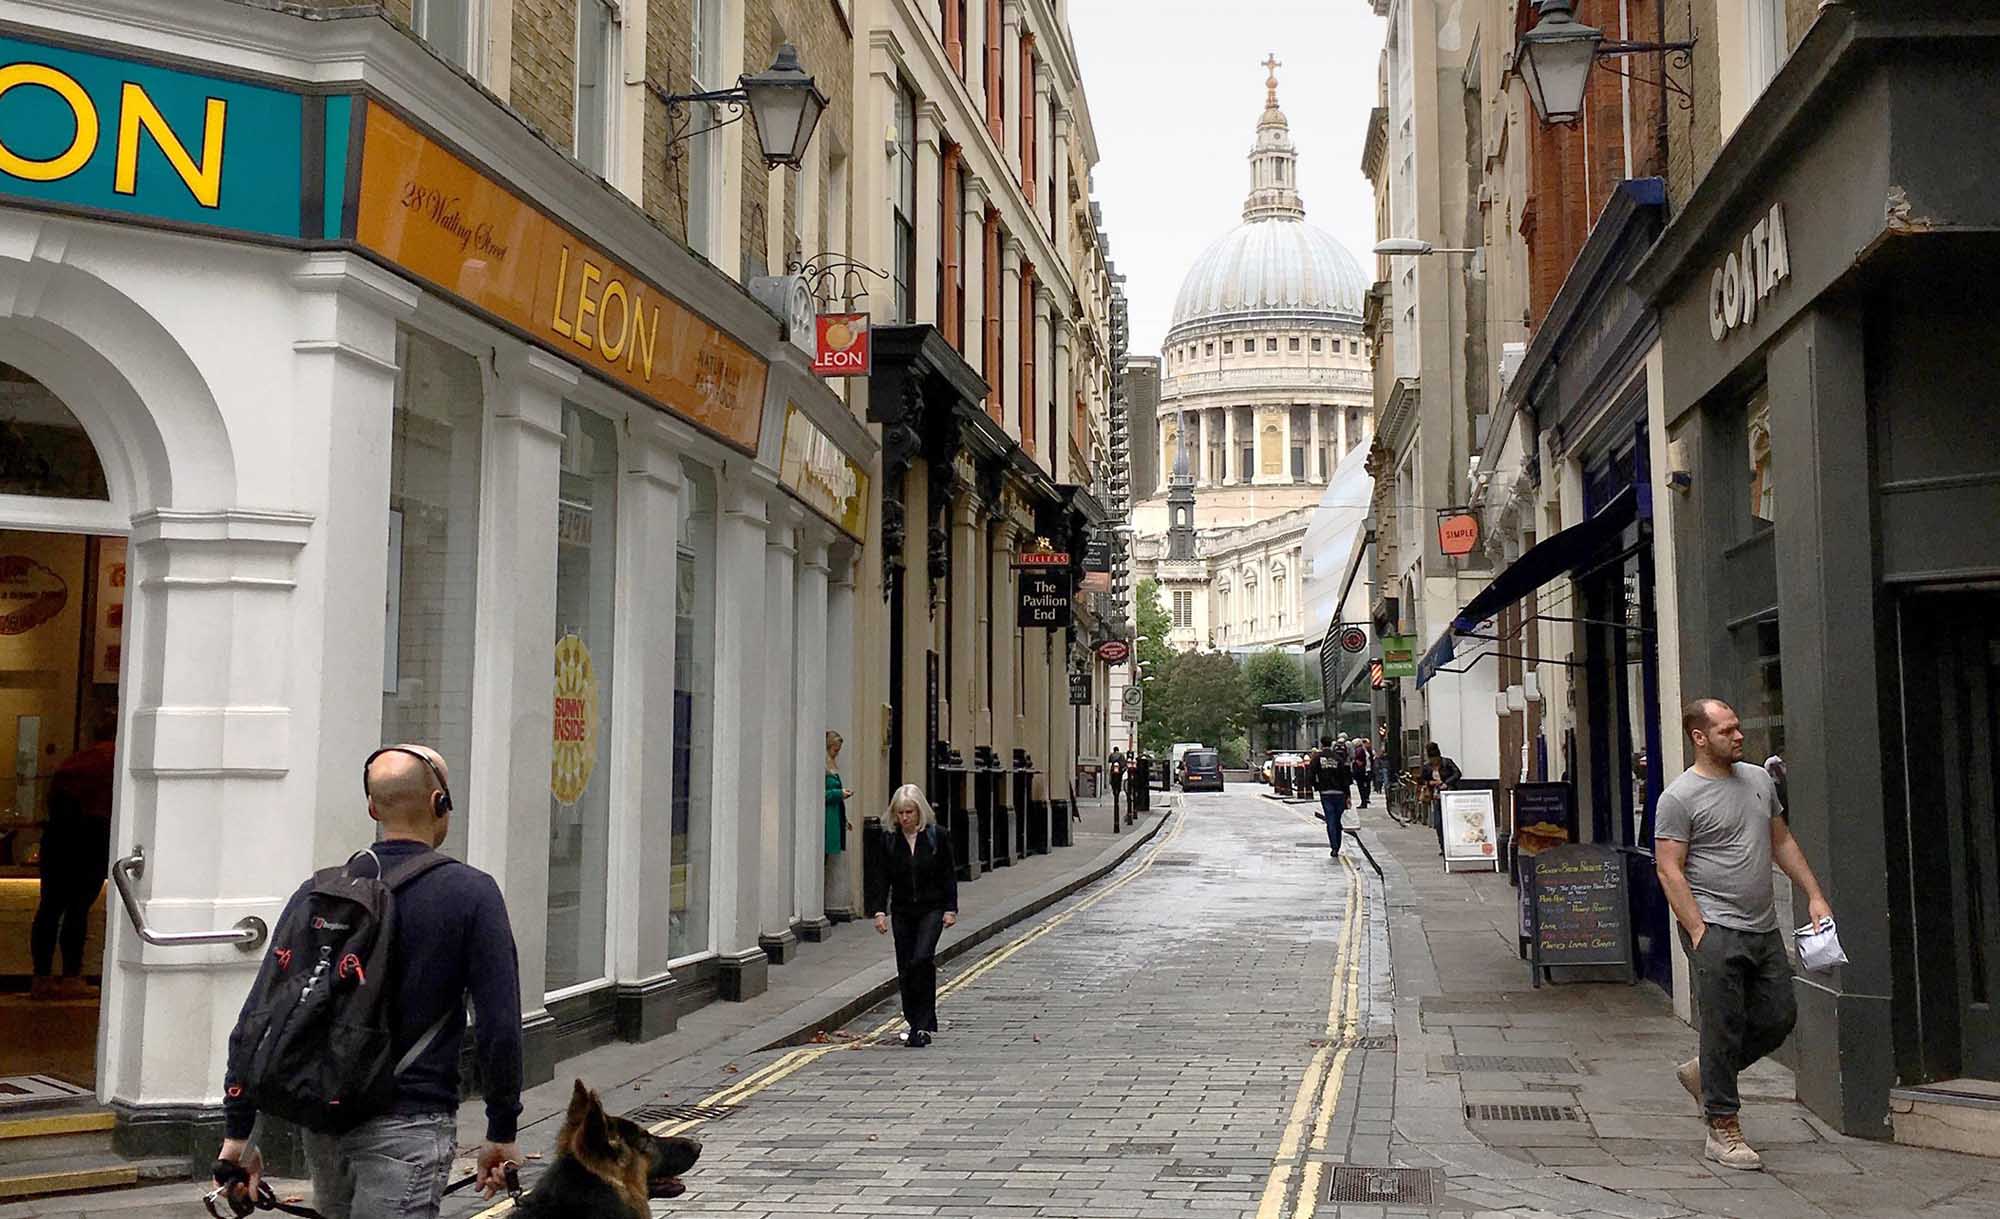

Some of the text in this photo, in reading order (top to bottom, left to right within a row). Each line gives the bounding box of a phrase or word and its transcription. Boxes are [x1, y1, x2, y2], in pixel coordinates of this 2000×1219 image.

[401, 180, 509, 261] 28 Watling Street
[1709, 202, 1790, 342] COSTA
[552, 244, 660, 383] LEON
[815, 351, 862, 367] LEON
[1446, 528, 1474, 540] SIMPLE
[1034, 581, 1056, 593] The
[1023, 595, 1067, 607] Pavilion
[1034, 608, 1056, 620] End
[555, 697, 585, 718] SUNNY
[554, 719, 585, 742] INSIDE
